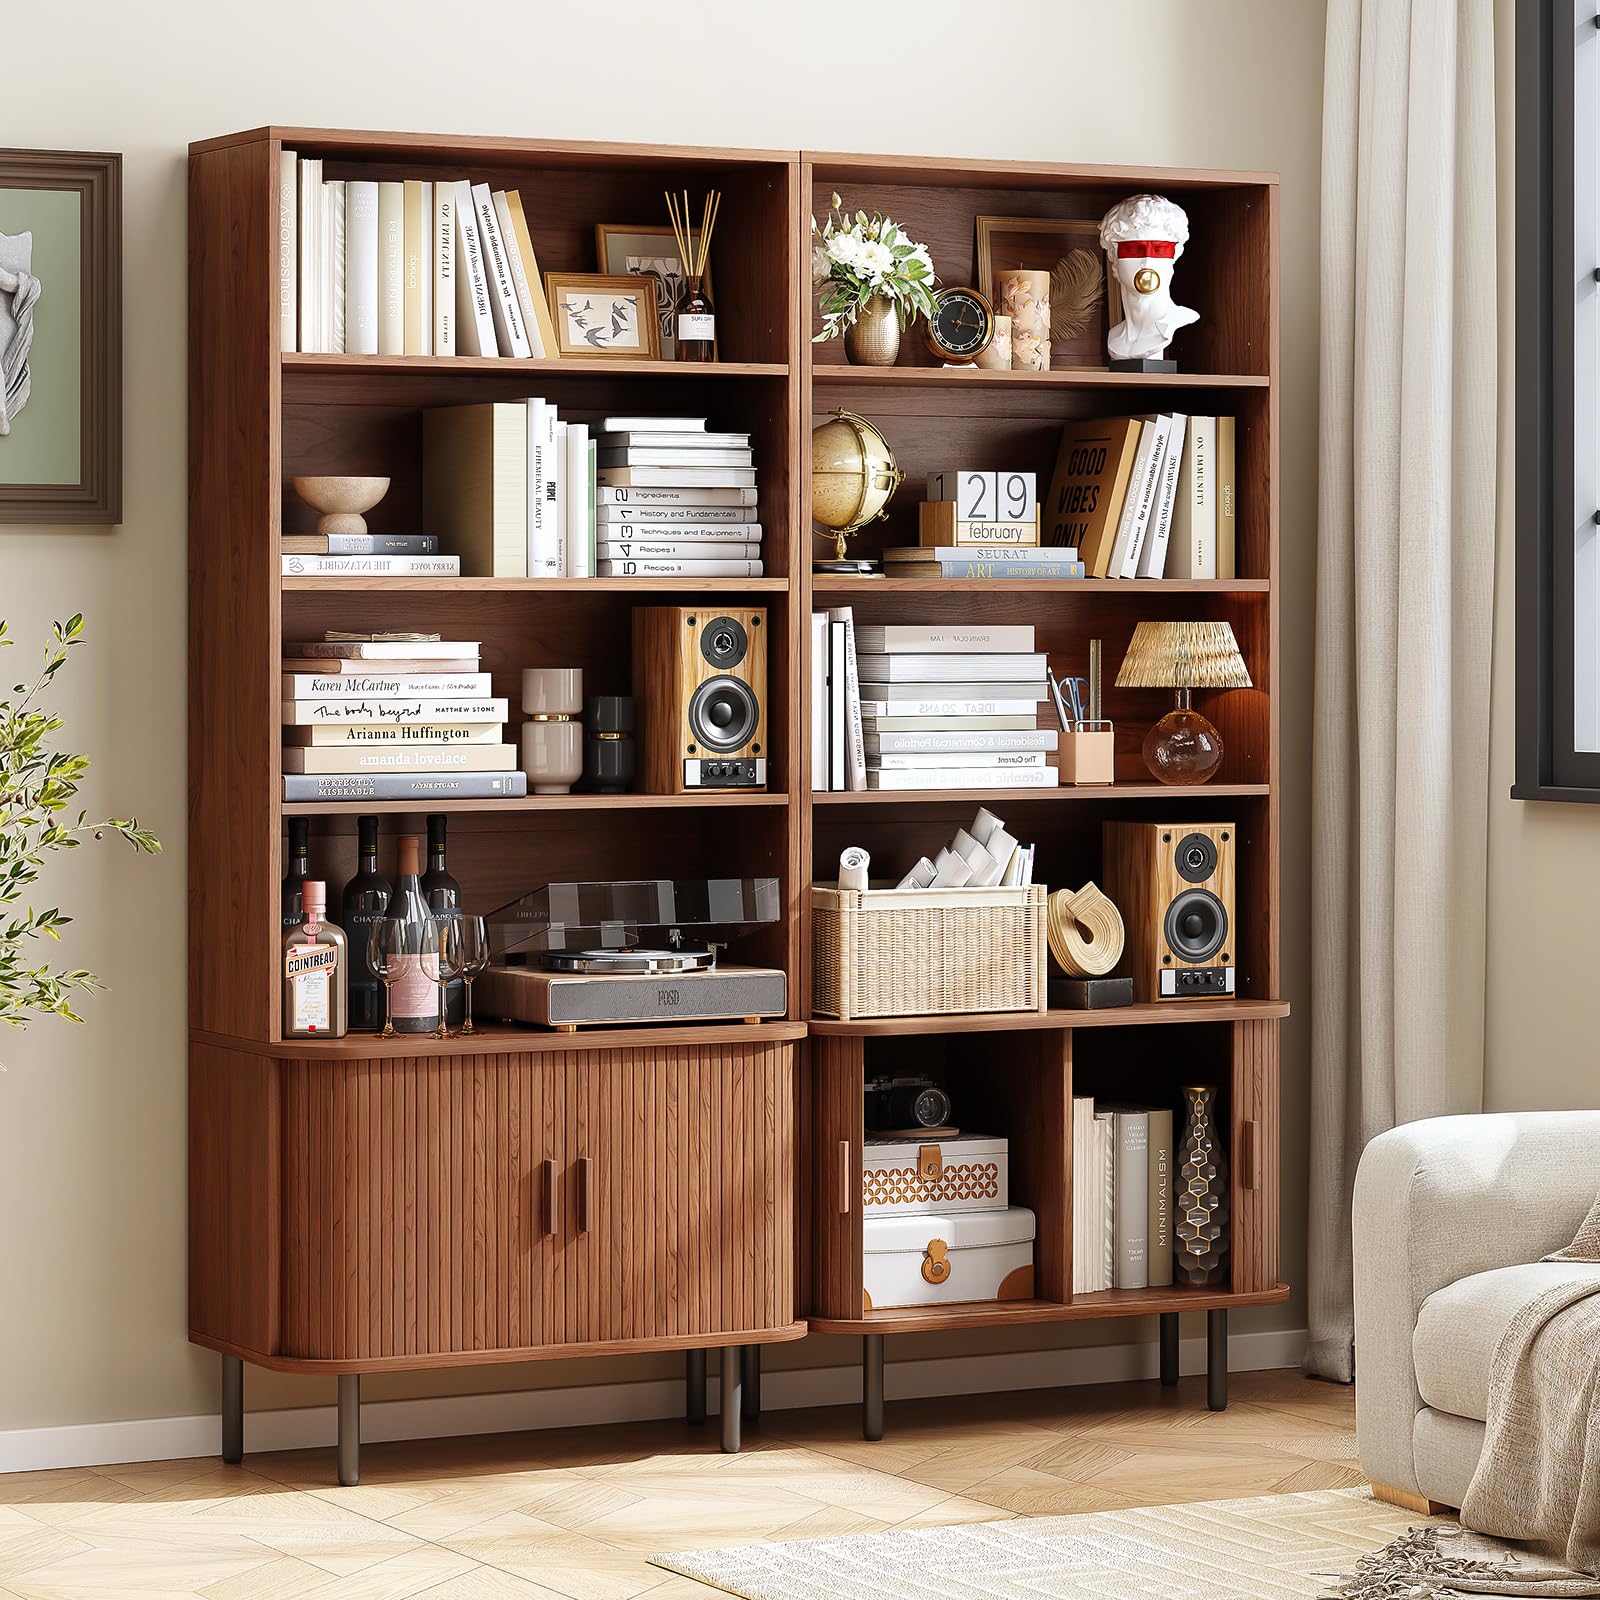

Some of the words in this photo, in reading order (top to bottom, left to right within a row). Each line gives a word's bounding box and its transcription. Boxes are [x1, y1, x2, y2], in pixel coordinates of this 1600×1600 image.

[1197, 436, 1204, 450] ON
[1068, 447, 1107, 477] GOOD
[1138, 509, 1146, 521] for
[1142, 463, 1158, 503] sustainable
[1152, 434, 1164, 462] lifestyle
[546, 482, 556, 502] PEOPLE
[615, 488, 629, 502] 2
[1058, 485, 1101, 514] VIBES
[1129, 480, 1140, 504] GOOD
[1158, 508, 1169, 538] DREAM
[1167, 455, 1177, 484] AWAKE
[1223, 485, 1233, 516] spherical
[620, 510, 633, 519] 1
[621, 525, 633, 538] 3
[969, 523, 1023, 543] february
[1052, 523, 1089, 549] ONLY
[620, 543, 632, 557] 4
[976, 549, 1028, 560] SEURAT
[623, 562, 636, 575] 5
[966, 564, 995, 577] ART
[1007, 567, 1036, 576] HISTORY
[1047, 567, 1061, 575] ART
[311, 679, 342, 692] Karen
[345, 678, 401, 694] McCartney
[313, 704, 341, 718] The
[344, 702, 373, 718] body
[379, 704, 421, 722] beyond
[346, 728, 396, 740] Arianna
[401, 726, 470, 742] Huffington
[360, 752, 410, 766] amanda
[414, 752, 466, 765] lovelace
[318, 778, 375, 787] PERFECTLY
[318, 787, 375, 796] MISERABLE
[287, 951, 335, 973] COINTREAU
[1158, 1149, 1167, 1246] MINIMALISM
